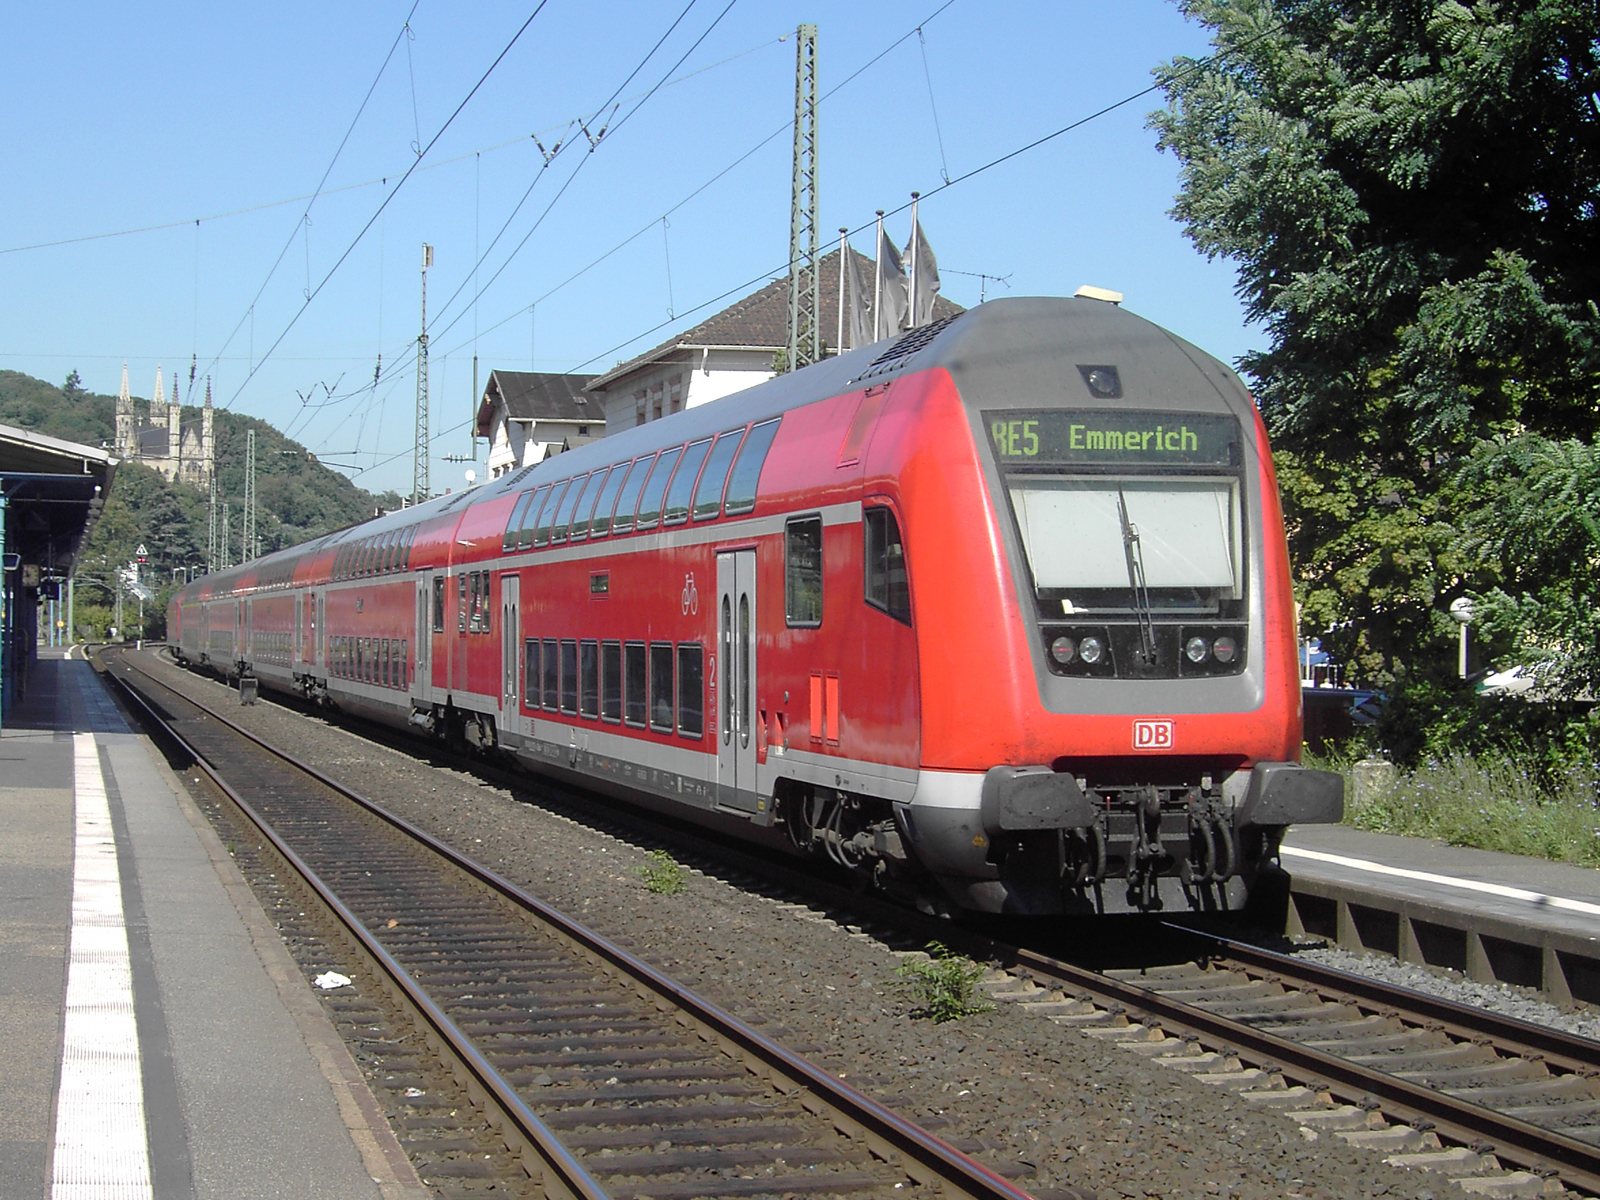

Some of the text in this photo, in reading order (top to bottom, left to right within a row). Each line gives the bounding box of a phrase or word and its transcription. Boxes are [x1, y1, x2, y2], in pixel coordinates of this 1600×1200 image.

[991, 420, 1197, 456] RE5 Emmerich
[1137, 723, 1170, 746] DB
